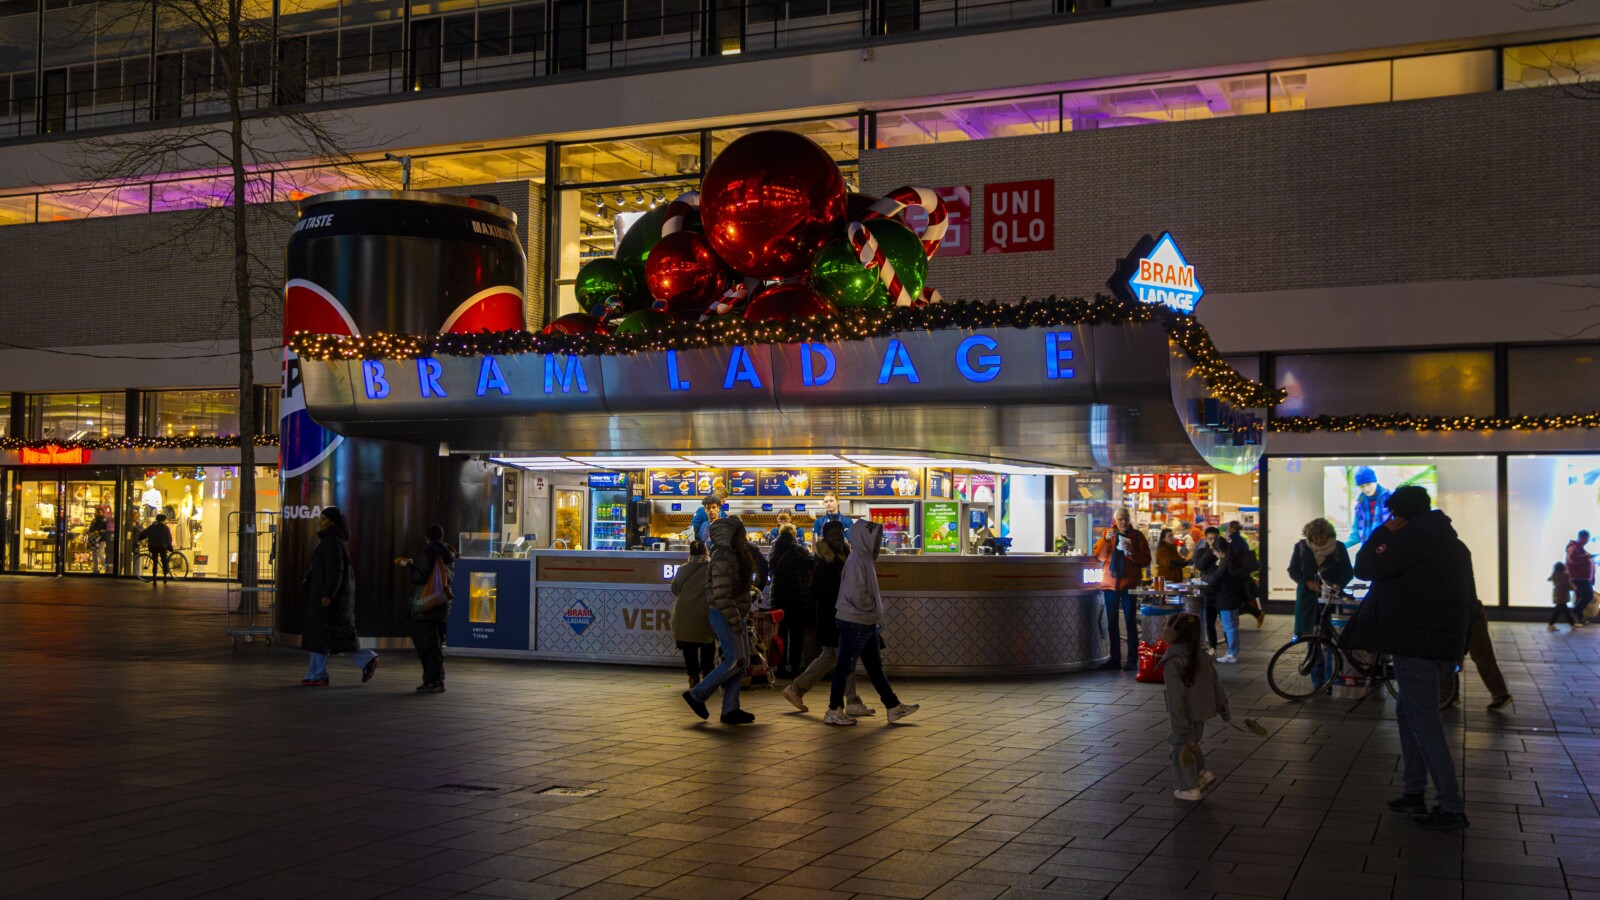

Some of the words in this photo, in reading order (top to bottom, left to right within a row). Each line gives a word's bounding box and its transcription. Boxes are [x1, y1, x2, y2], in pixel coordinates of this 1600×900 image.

[992, 189, 1040, 215] UNI
[305, 213, 334, 230] TASTE
[992, 218, 1045, 249] QLO
[1140, 260, 1193, 288] BRAM
[1140, 287, 1194, 311] LADAGE
[361, 353, 589, 399] BRAM
[666, 331, 1074, 391] LADAGE
[1168, 477, 1195, 491] QLO
[283, 505, 336, 520] SUGA
[567, 609, 591, 617] BRAM
[567, 617, 591, 625] LADAGE
